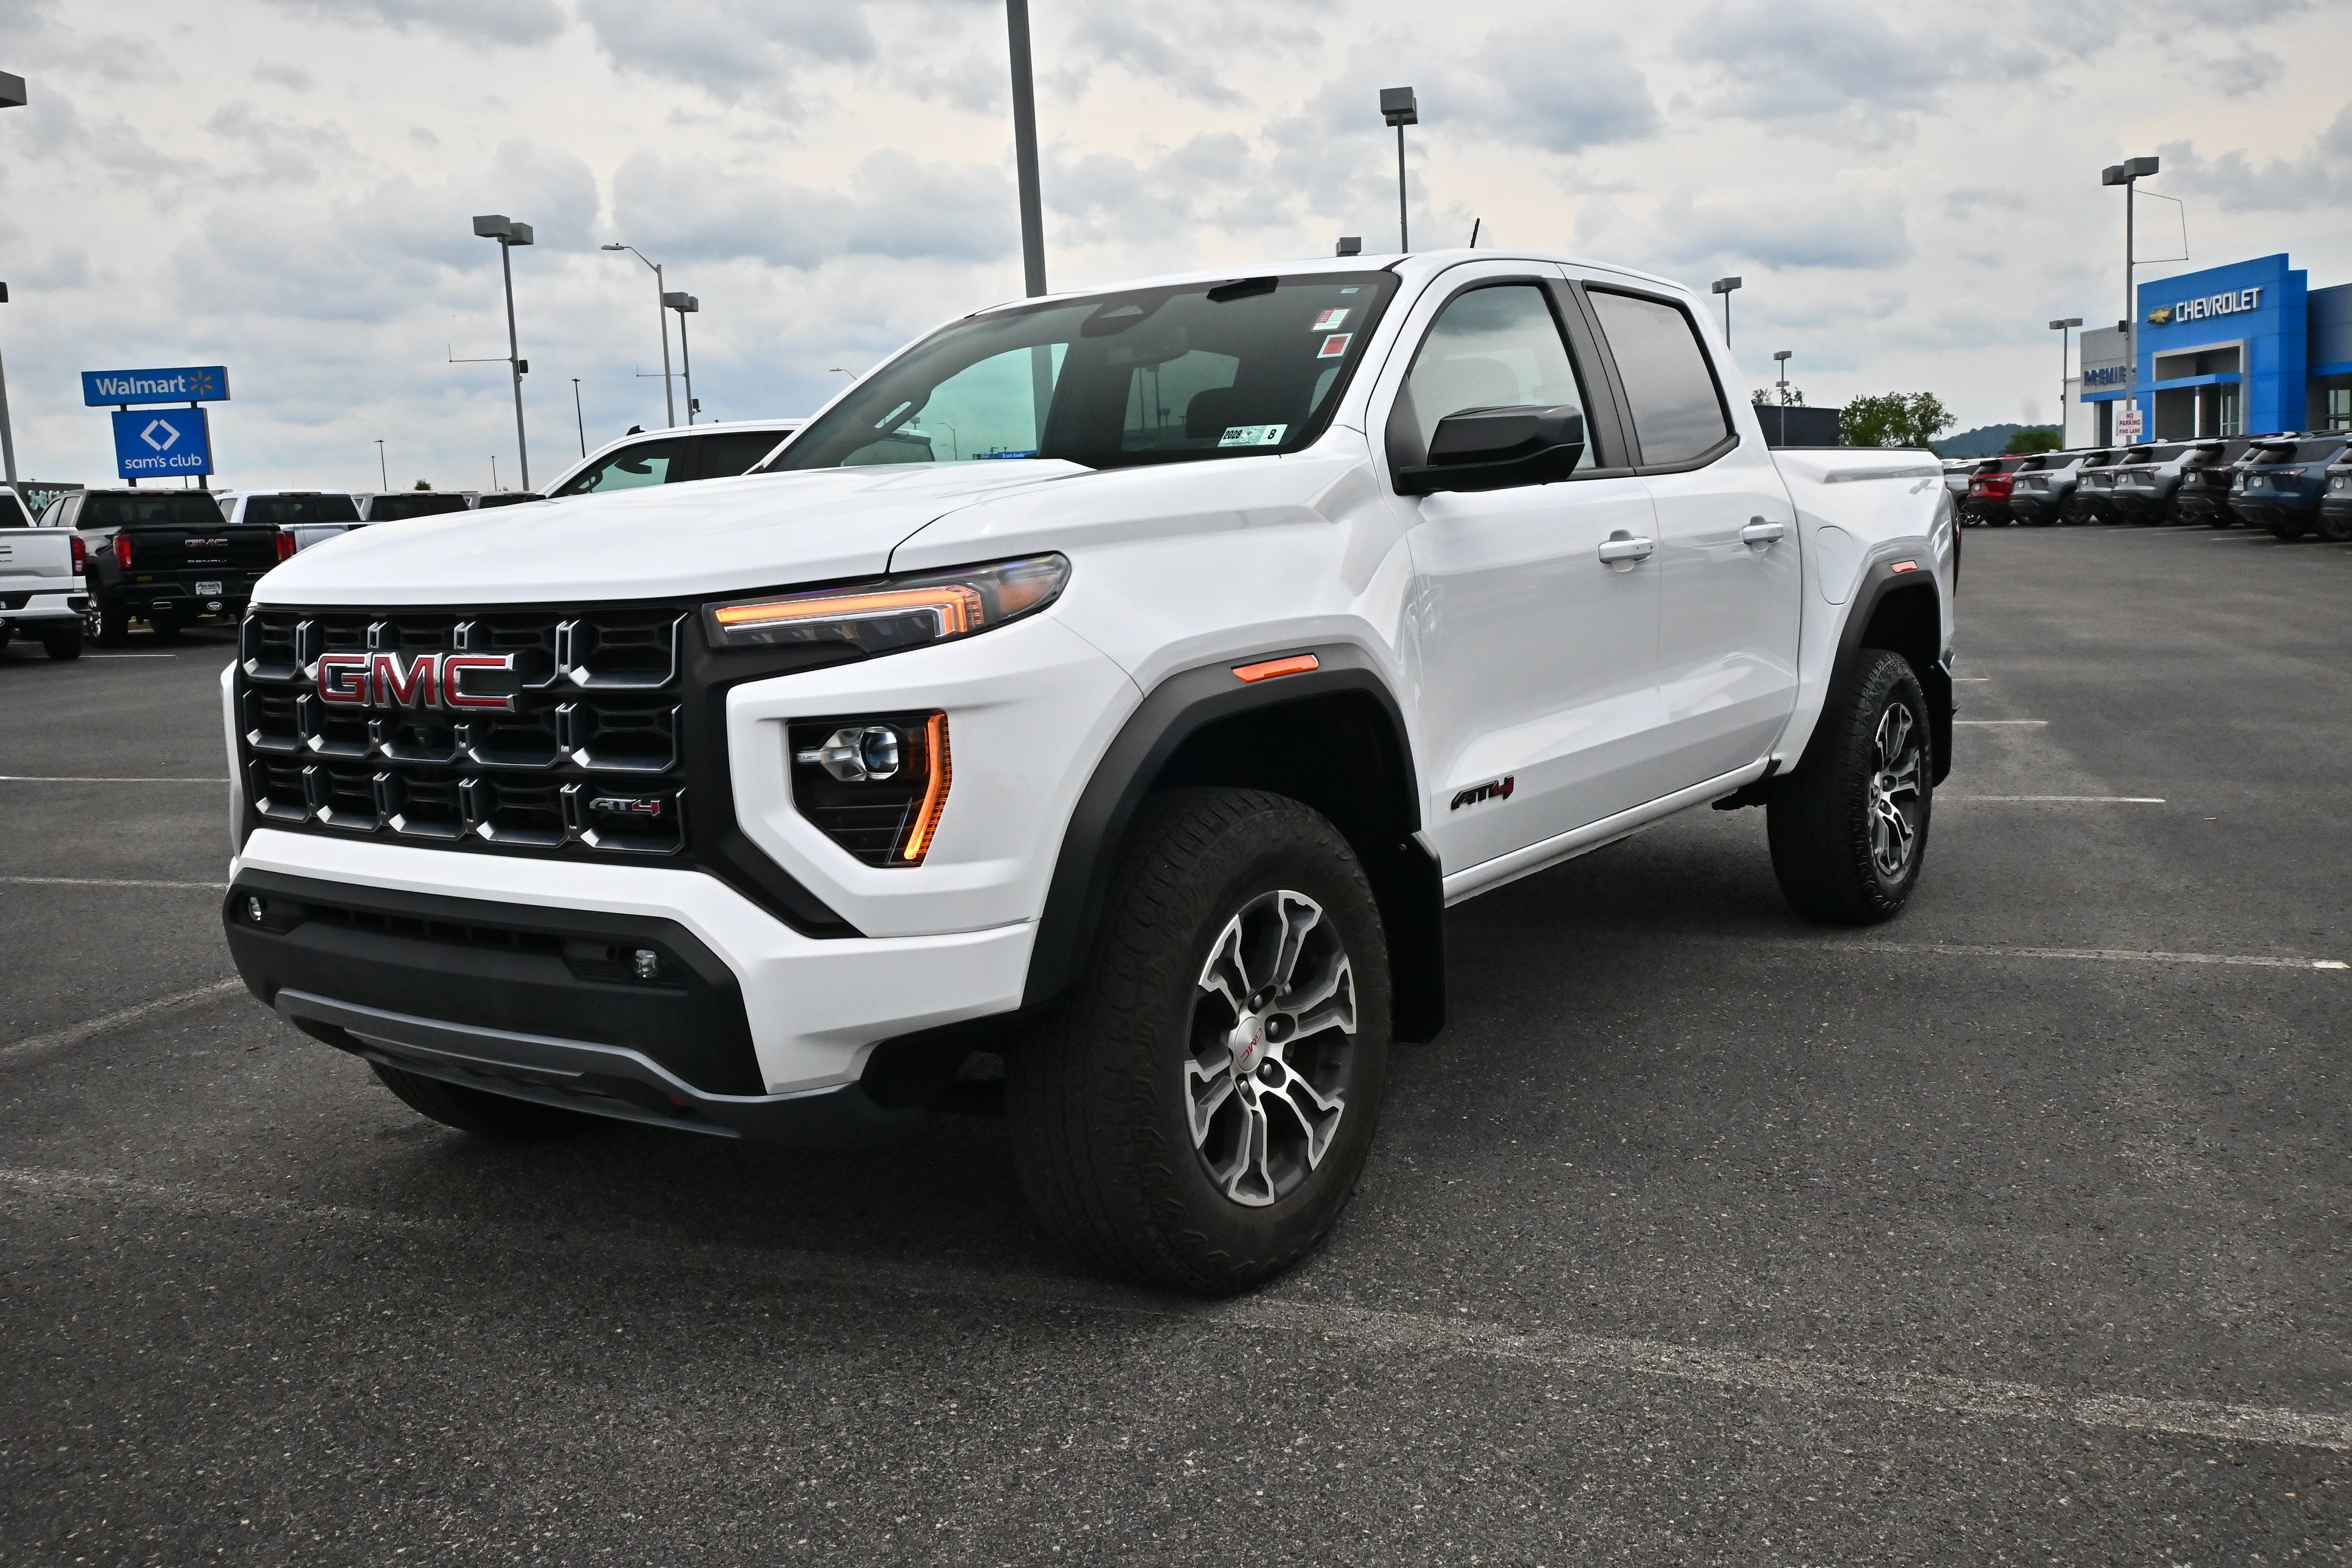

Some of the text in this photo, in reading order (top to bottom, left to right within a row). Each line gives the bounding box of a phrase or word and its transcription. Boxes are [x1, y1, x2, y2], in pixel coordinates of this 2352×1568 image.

[2176, 287, 2259, 322] CHEVROLET
[96, 375, 186, 396] Walmart
[1223, 429, 1277, 440] 2028 8
[125, 453, 202, 469] sam's club
[185, 539, 228, 547] GMC
[317, 652, 516, 713] GMC
[1451, 775, 1514, 810] AT4
[589, 798, 661, 817] AT4
[1240, 1026, 1262, 1062] GMC
